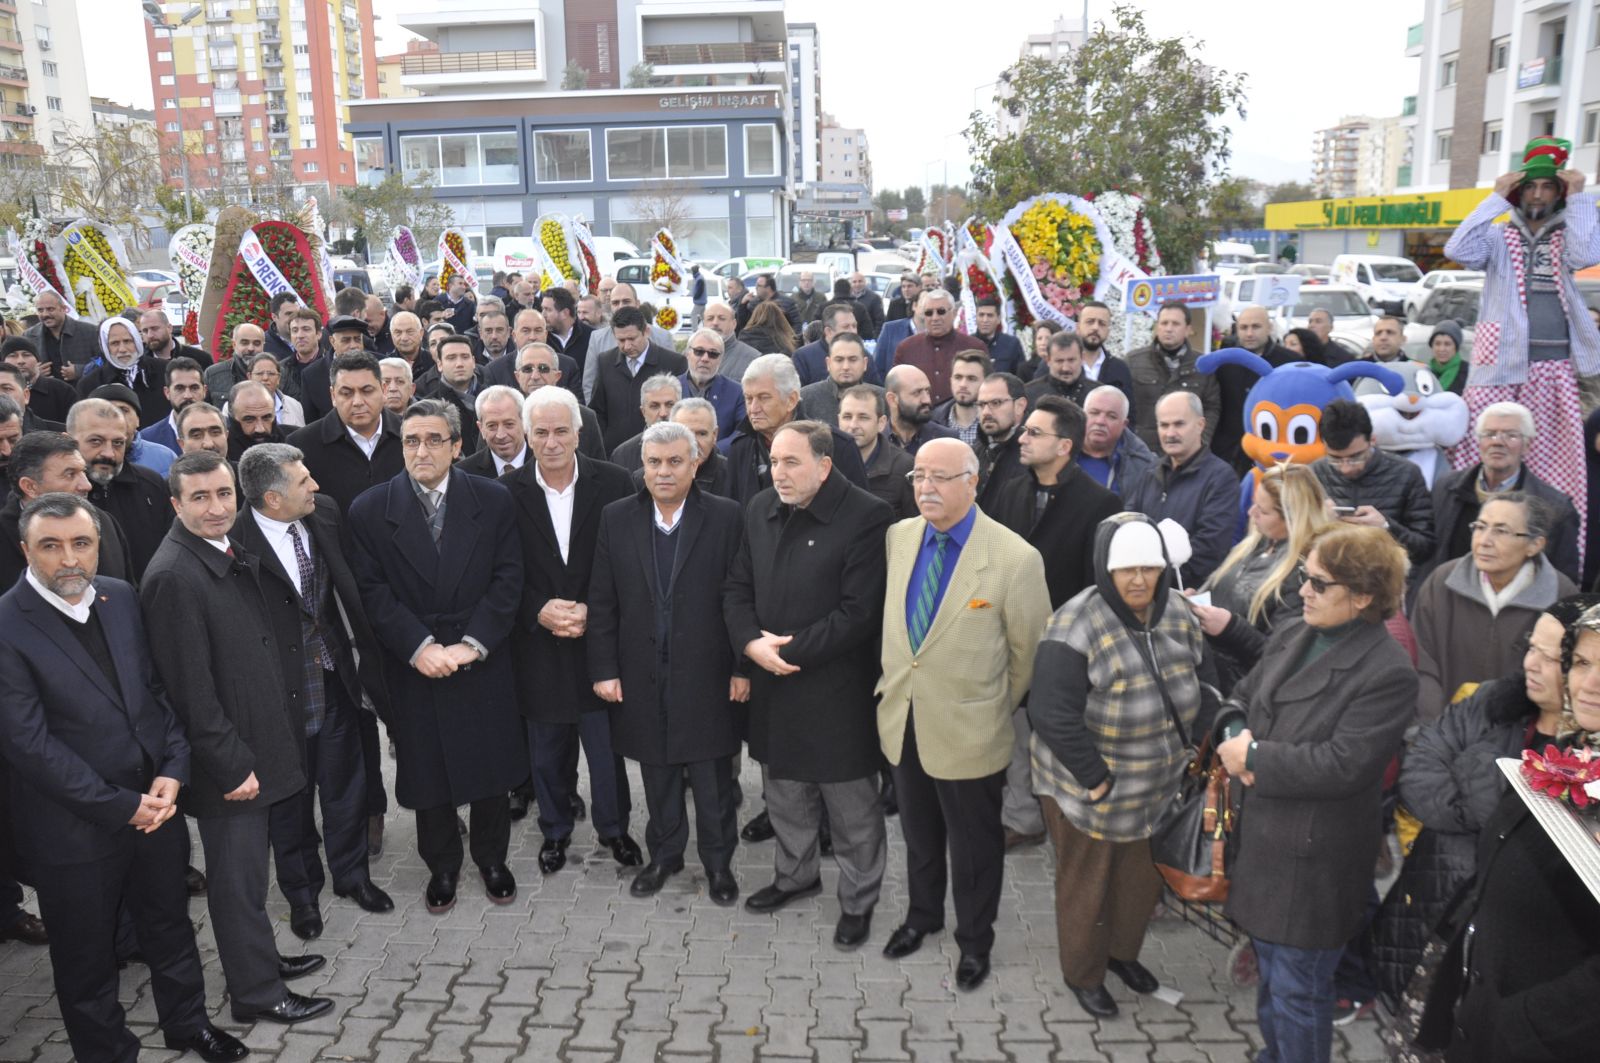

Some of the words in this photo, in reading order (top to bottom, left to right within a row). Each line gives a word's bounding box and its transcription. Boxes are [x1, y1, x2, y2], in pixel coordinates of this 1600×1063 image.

[659, 95, 713, 110] GELİŞİM
[717, 94, 768, 108] İNŞAAT
[79, 244, 117, 285] egeden
[255, 257, 287, 295] PRENS
